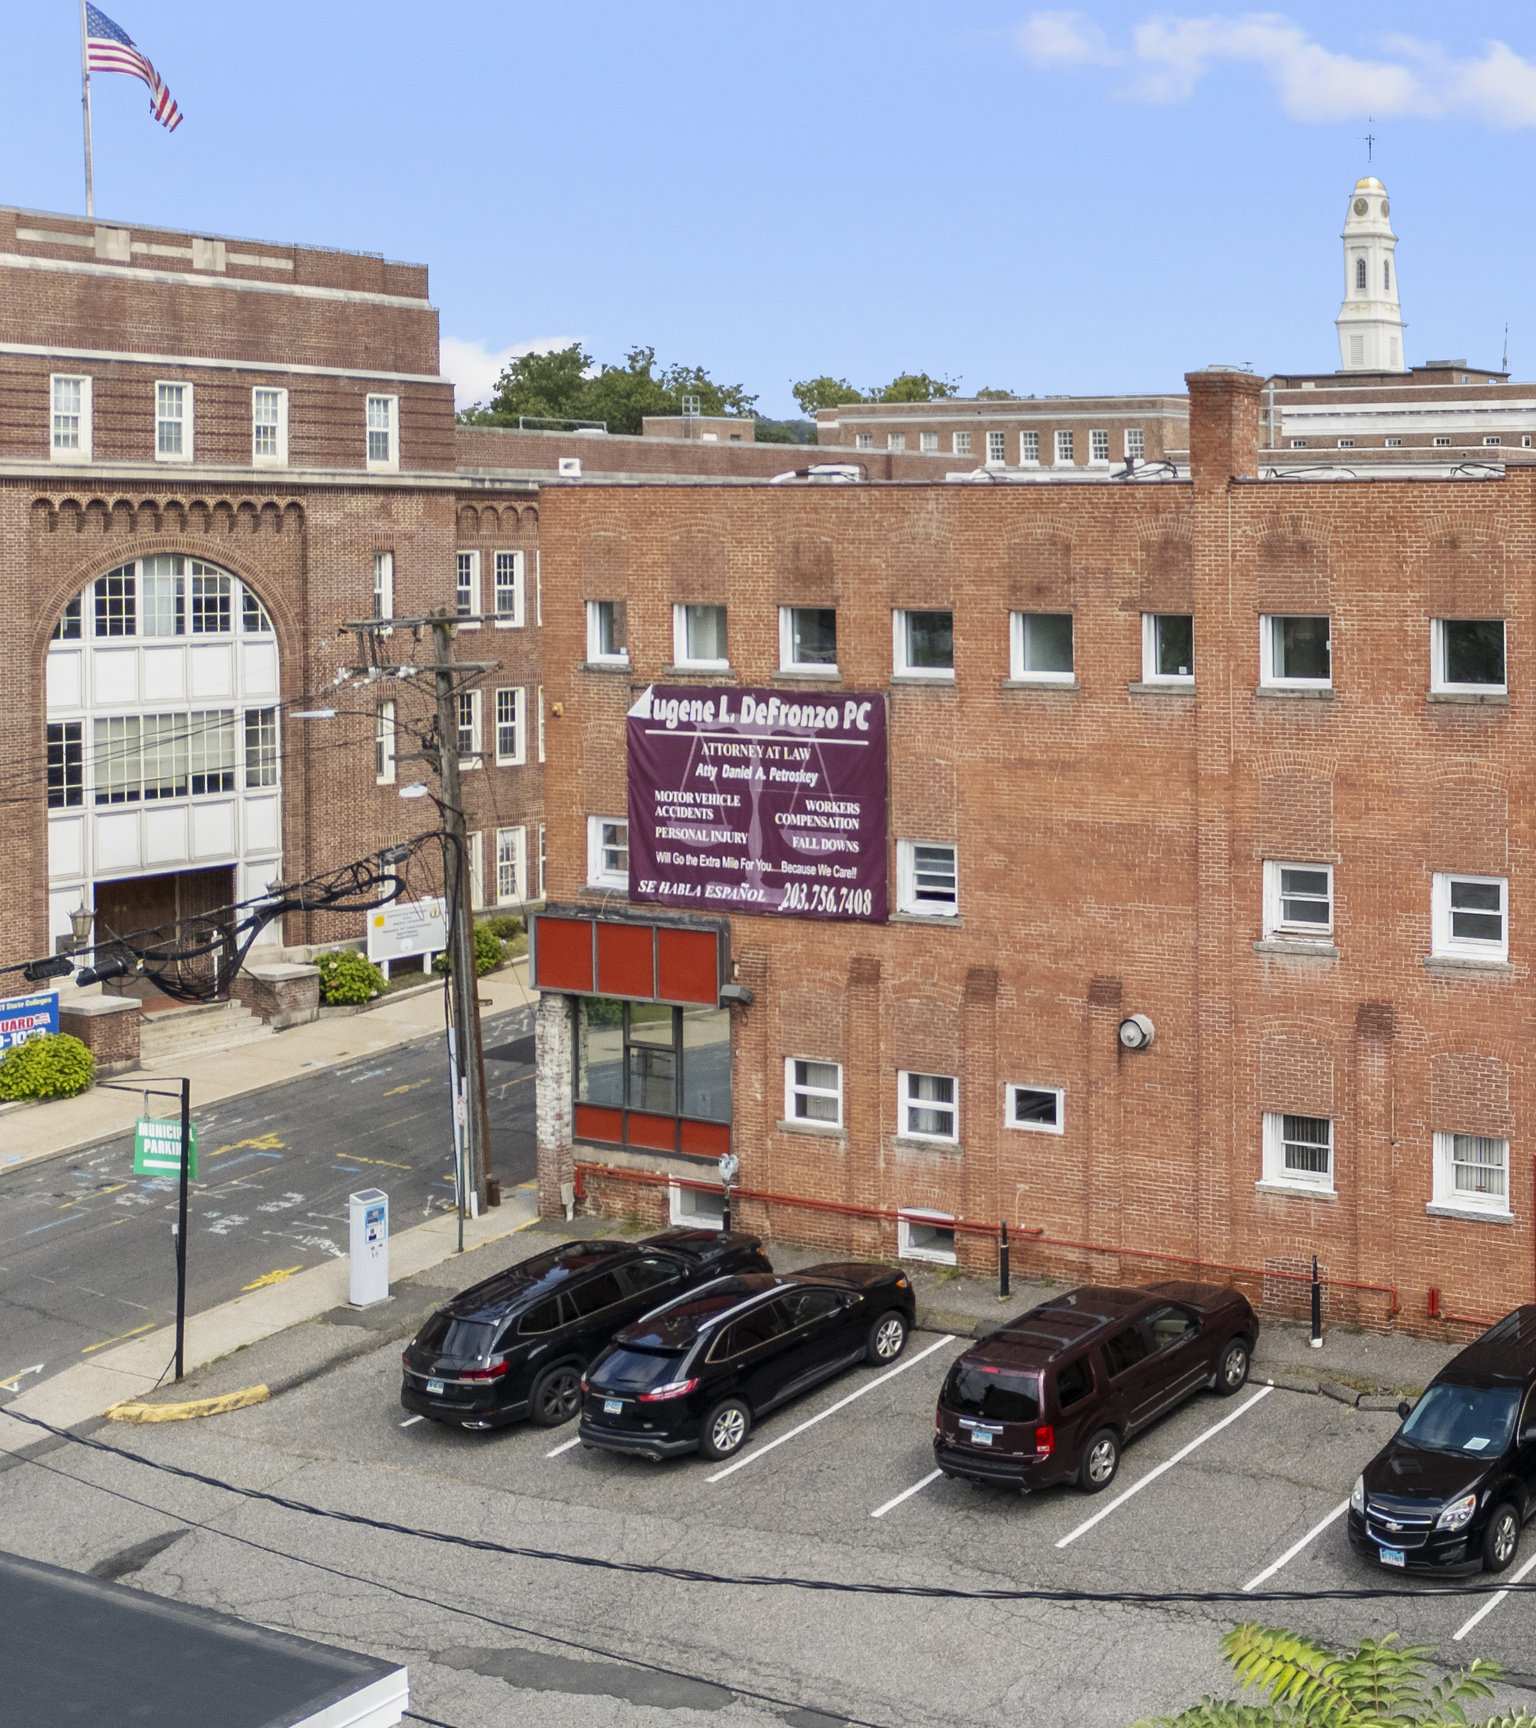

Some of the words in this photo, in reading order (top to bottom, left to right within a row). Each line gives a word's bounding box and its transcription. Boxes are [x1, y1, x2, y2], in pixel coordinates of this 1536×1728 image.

[648, 693, 715, 728] ugene
[719, 694, 735, 723] L.
[740, 695, 839, 728] DeFronzo
[843, 701, 872, 730] PC
[701, 742, 765, 758] ATTORNEY
[765, 746, 781, 759] AT
[783, 747, 812, 760] LAW
[695, 762, 718, 781] Atty
[722, 763, 752, 779] Daniel
[755, 766, 766, 780] A.
[769, 766, 819, 787] Petroskey
[655, 790, 694, 804] MOTOR
[694, 792, 741, 807] VEHICLE
[805, 799, 861, 815] WORKERS
[655, 805, 714, 820] ACCIDENTS
[774, 812, 860, 830] COMPENSATION
[655, 826, 709, 842] PERSONAL
[710, 830, 749, 844] INJURY
[792, 836, 820, 849] FALL
[821, 838, 860, 853] DOWNS
[656, 850, 672, 864] Will
[672, 852, 685, 865] Go
[685, 853, 698, 867] the
[699, 854, 720, 868] Extra
[722, 856, 739, 870] Mile
[740, 857, 755, 871] For
[817, 863, 832, 877] We
[833, 864, 858, 879] Care!!
[638, 879, 658, 893] SE
[658, 881, 702, 897] HABLA
[704, 882, 766, 903] ESPAÑOL
[778, 881, 872, 916] 203.756.7408
[0, 1015, 35, 1033] UARD
[138, 1121, 195, 1142] MUNICIPL
[143, 1138, 182, 1156] PARKIN
